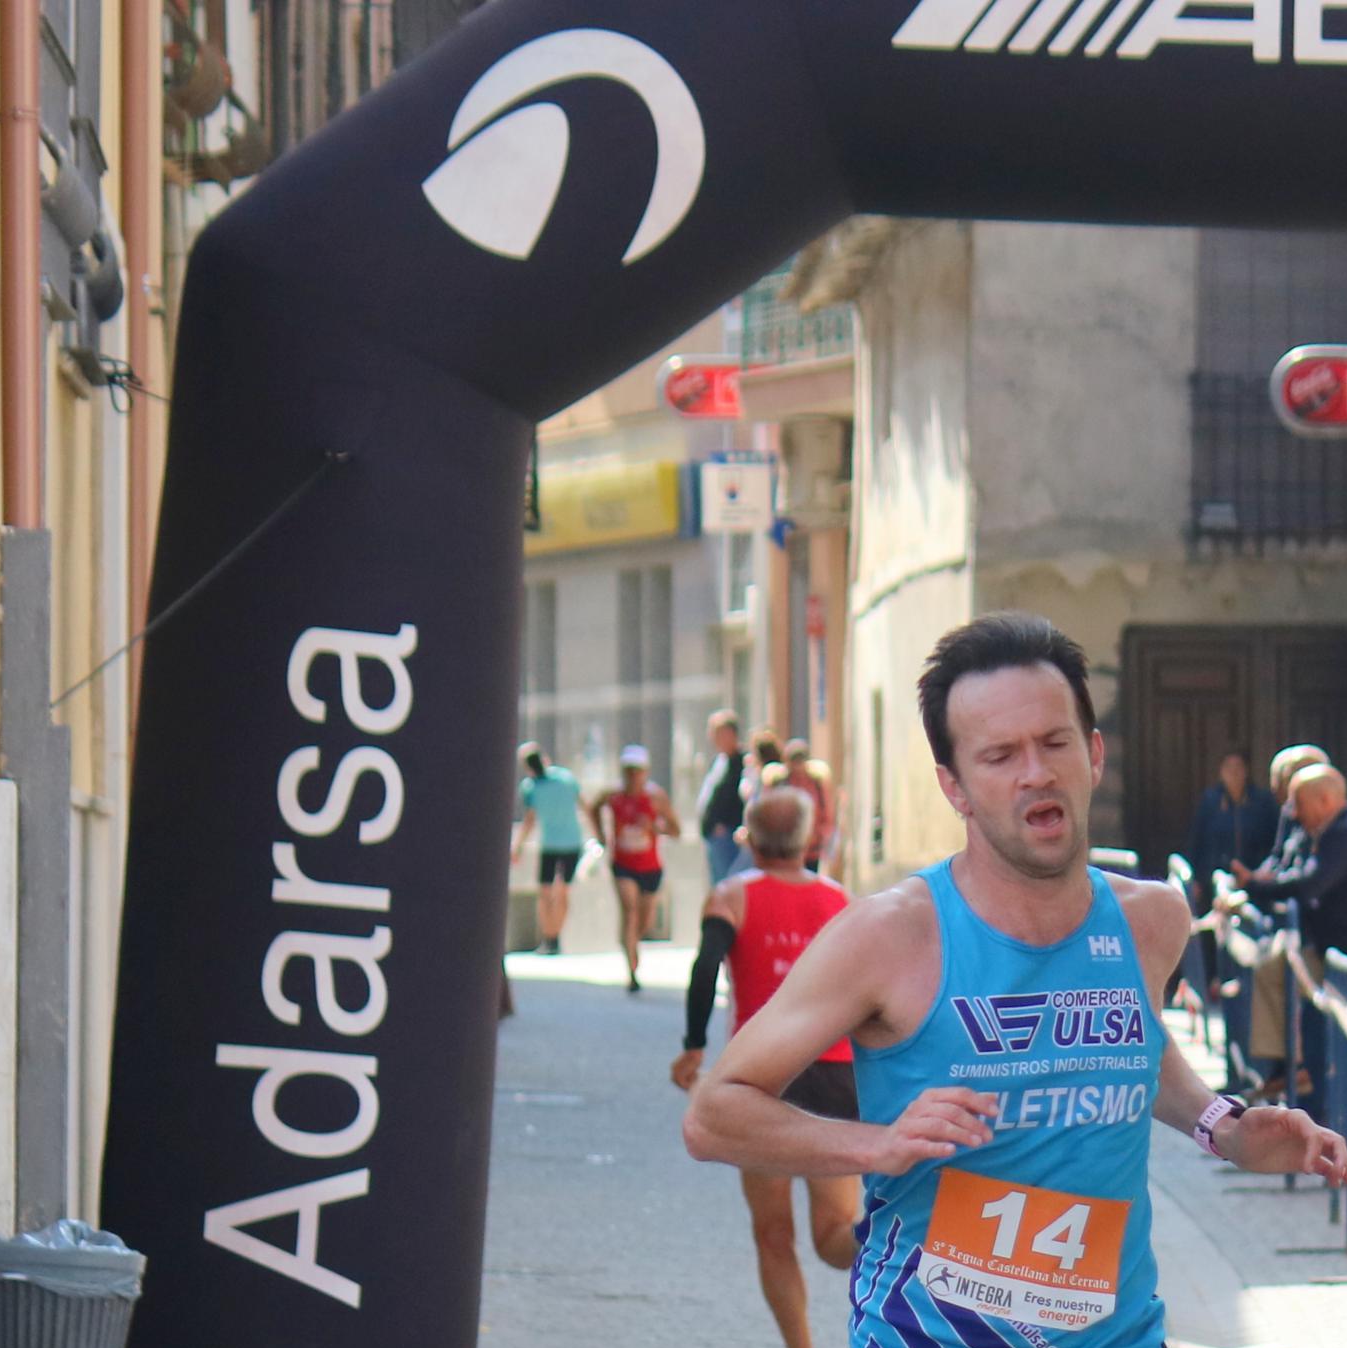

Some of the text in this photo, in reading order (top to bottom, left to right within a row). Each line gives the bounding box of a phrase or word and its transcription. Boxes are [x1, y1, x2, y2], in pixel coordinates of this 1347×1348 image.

[203, 622, 419, 1310] Adarsa
[1052, 988, 1140, 1008] COMERCIAL
[1053, 1008, 1145, 1048] ULSA
[949, 1055, 1148, 1078] SUMINISTROS INDUSTRIALES
[976, 1083, 1147, 1131] LETISMO
[981, 1191, 1091, 1270] 14
[948, 1244, 984, 1267] Legua
[987, 1259, 1049, 1282] Castellana
[1052, 1272, 1066, 1285] del
[1069, 1274, 1110, 1290] Cerrato
[955, 1276, 1012, 1308] INTEGRA
[1024, 1291, 1103, 1314] Eres nuestra
